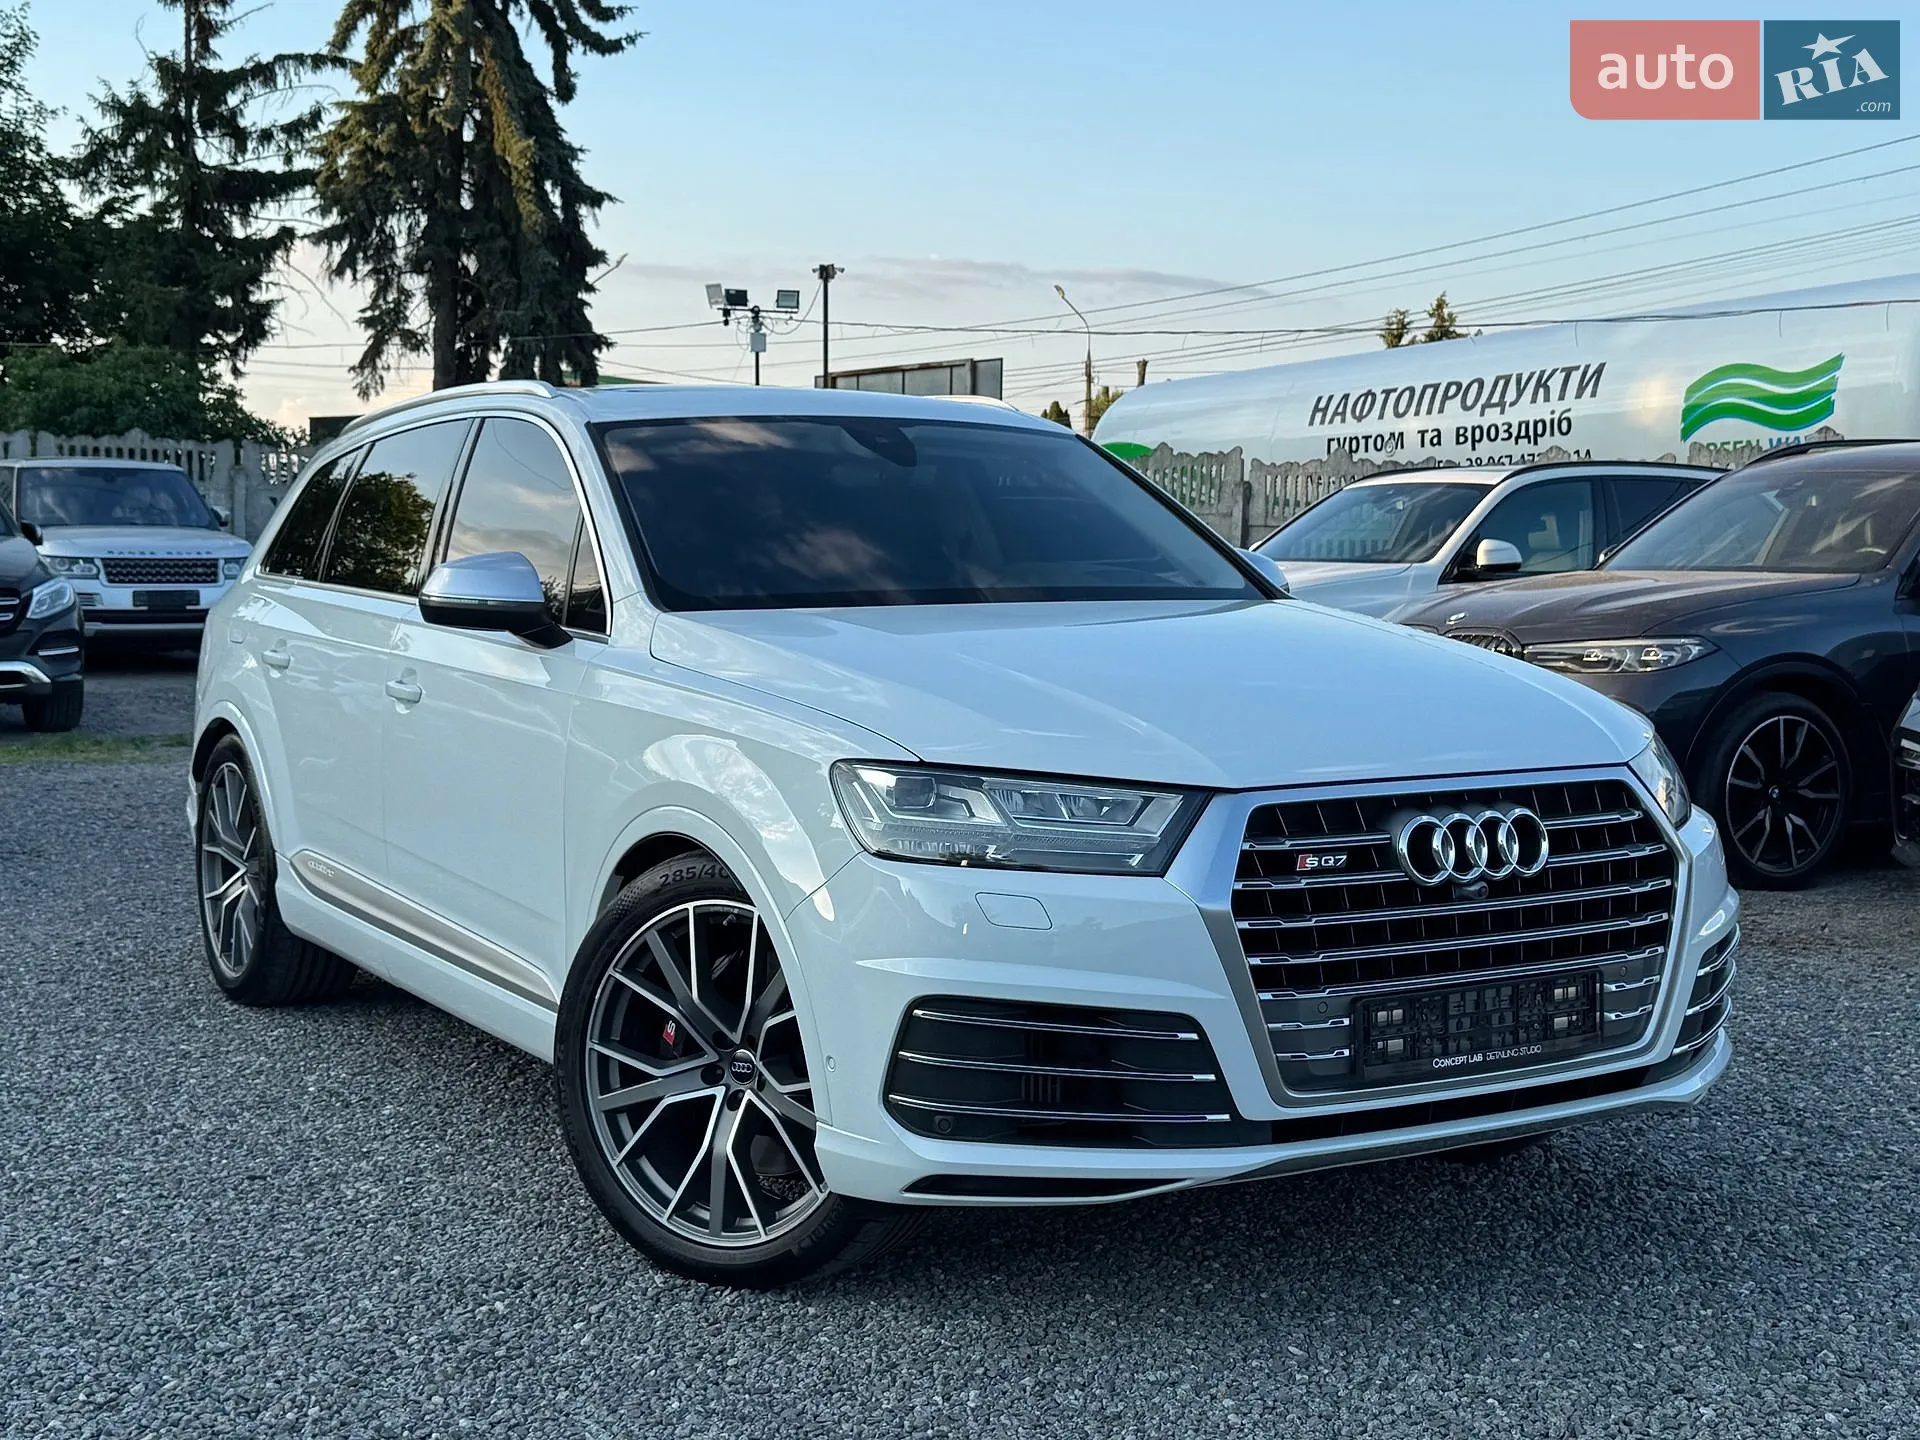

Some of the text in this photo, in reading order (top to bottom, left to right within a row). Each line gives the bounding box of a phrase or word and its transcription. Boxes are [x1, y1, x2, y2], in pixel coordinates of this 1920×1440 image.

[1308, 362, 1607, 427] НАФТОПРОДУКТИ
[1417, 428, 1442, 448] та
[1455, 408, 1573, 451] вроздріб
[1300, 855, 1347, 869] SQ7
[1432, 1055, 1468, 1069] CONCEPT
[1468, 1053, 1483, 1063] LAB
[1519, 1044, 1542, 1056] STUDIO
